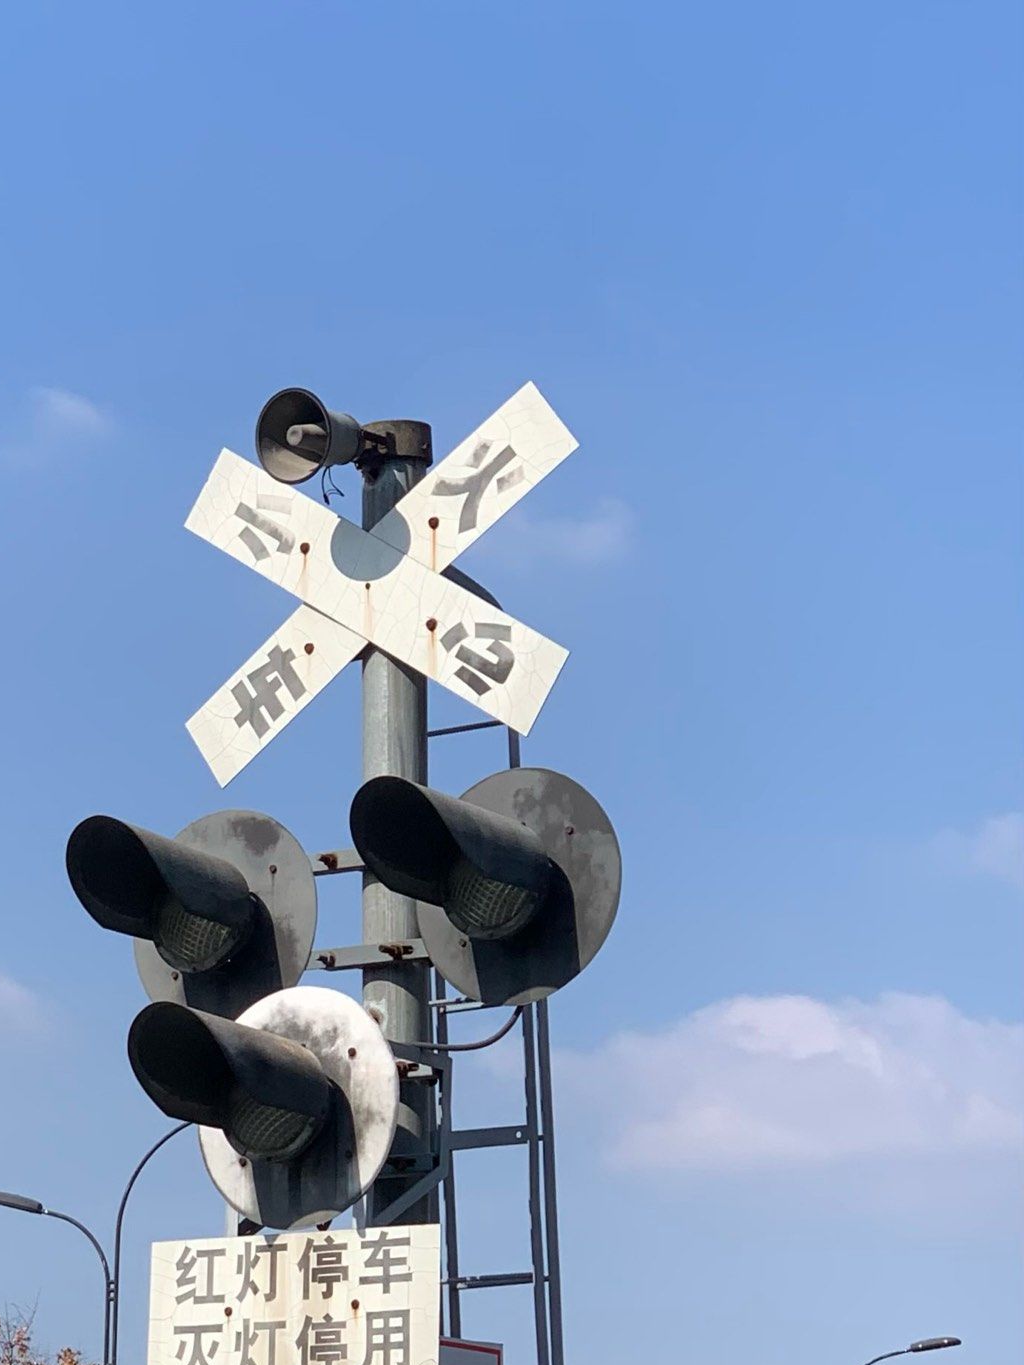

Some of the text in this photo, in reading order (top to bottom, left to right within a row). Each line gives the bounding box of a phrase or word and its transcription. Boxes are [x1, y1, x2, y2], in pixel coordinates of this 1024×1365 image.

[231, 440, 524, 739] 火 车
[440, 622, 515, 696] 心
[175, 1231, 413, 1305] 红灯停车
